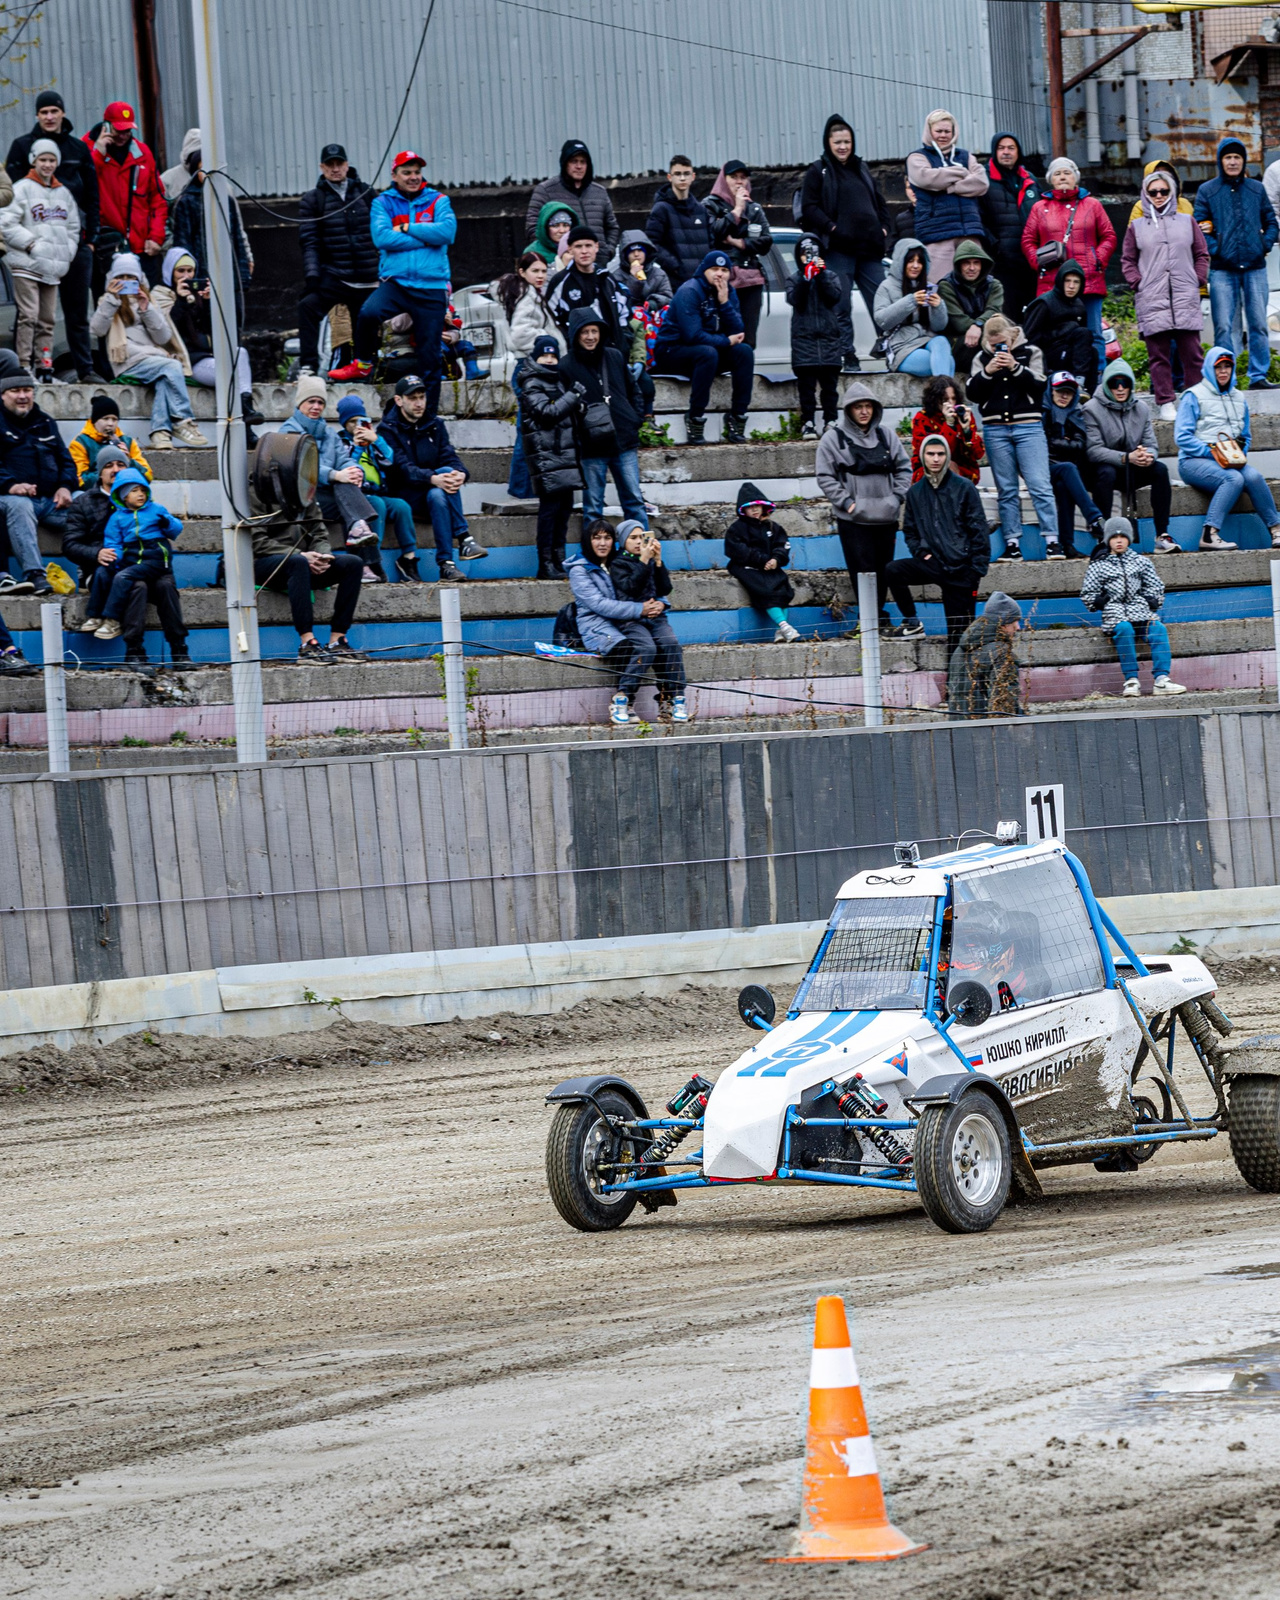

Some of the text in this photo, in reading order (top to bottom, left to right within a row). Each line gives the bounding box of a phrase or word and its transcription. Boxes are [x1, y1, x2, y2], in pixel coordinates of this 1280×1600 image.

[1030, 789, 1058, 839] 11
[781, 1045, 823, 1057] 11
[986, 1026, 1067, 1063] ЮШКО КИРИЛЛ
